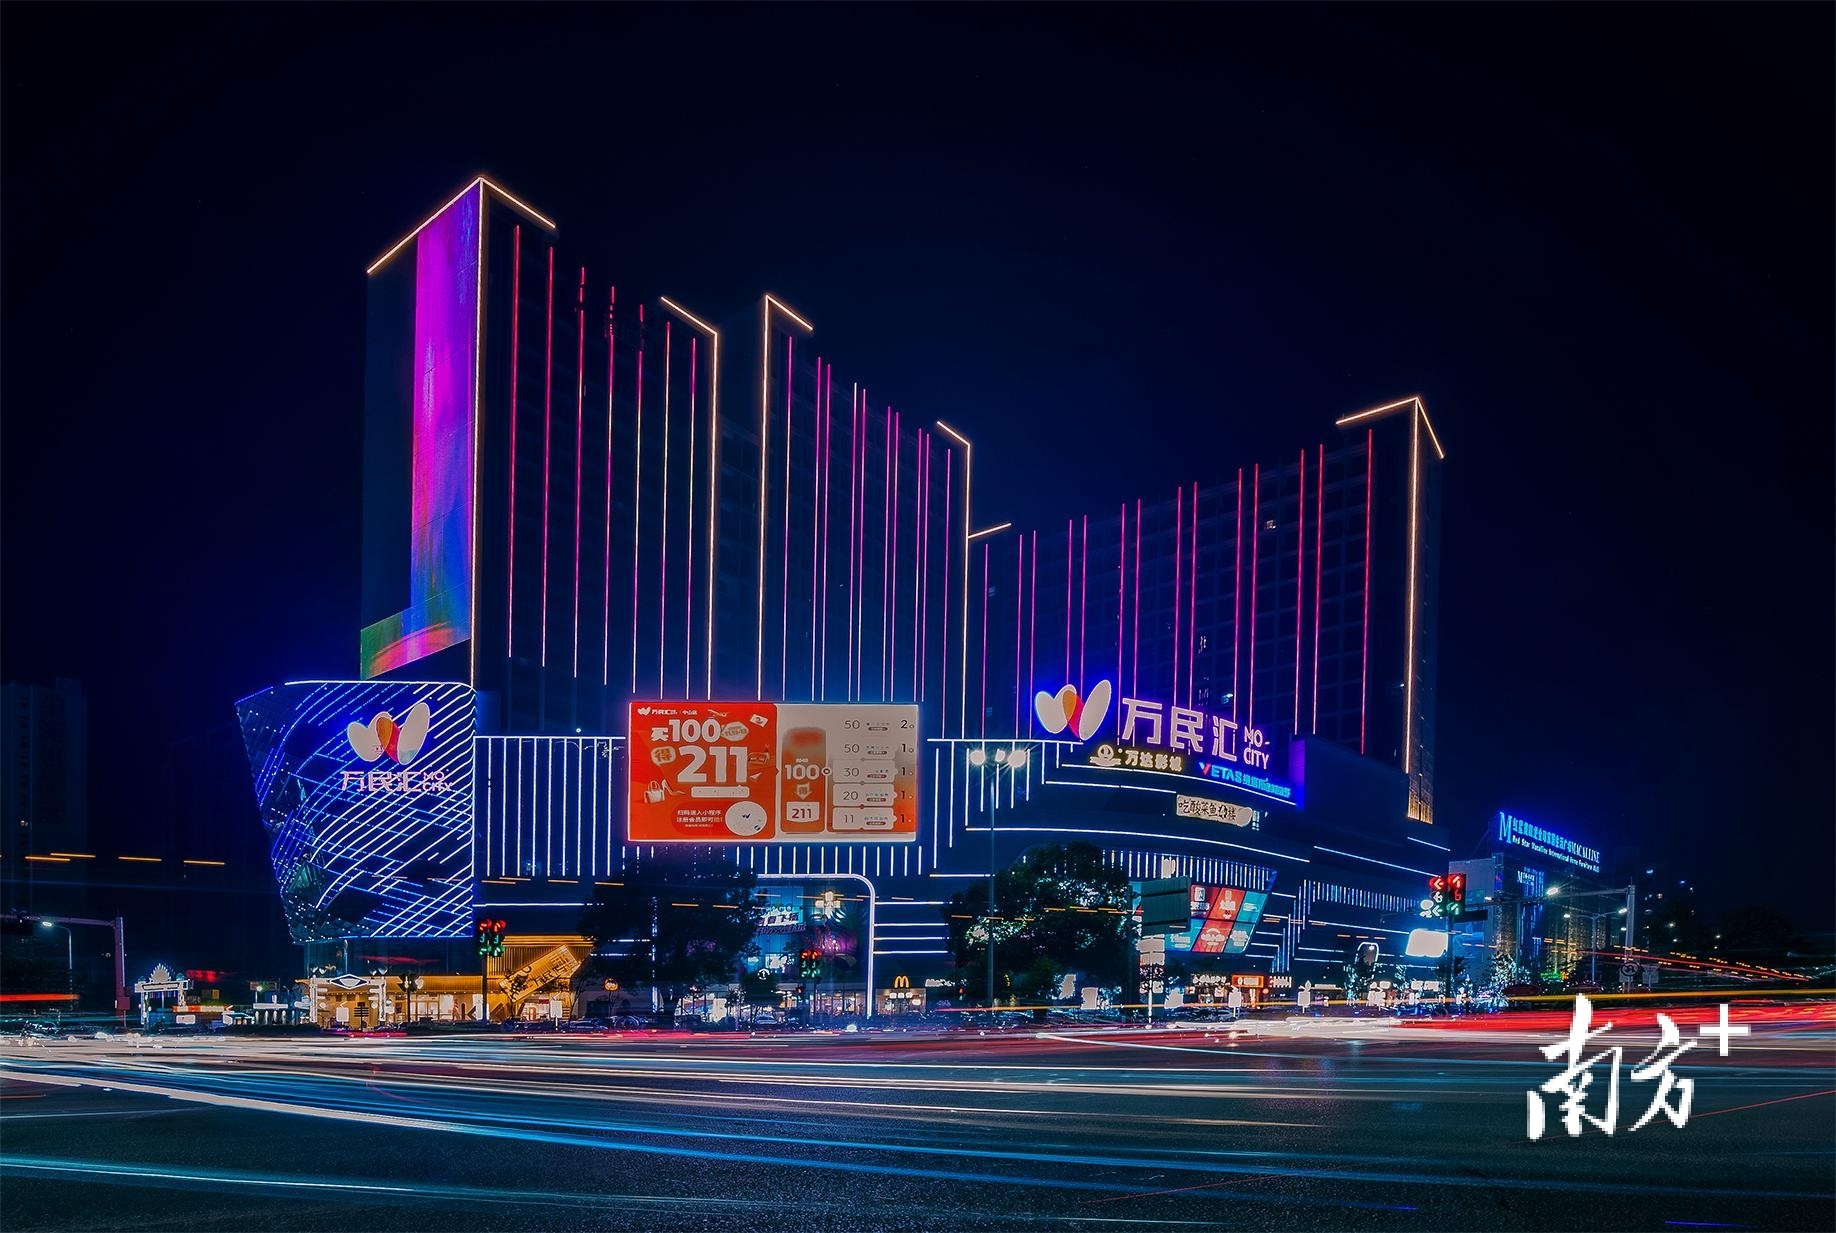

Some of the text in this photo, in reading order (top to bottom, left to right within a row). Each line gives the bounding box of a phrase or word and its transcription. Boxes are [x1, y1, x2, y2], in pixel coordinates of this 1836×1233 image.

[844, 719, 860, 730] 50
[1122, 698, 1238, 762] 万民汇
[844, 743, 860, 754] 50
[677, 745, 748, 783] 211
[1243, 748, 1269, 770] CITY
[784, 764, 820, 780] 100
[843, 767, 860, 777] 30
[340, 771, 422, 792] 万民汇
[842, 790, 859, 801] 20
[791, 808, 812, 819] 211
[843, 814, 854, 823] 11
